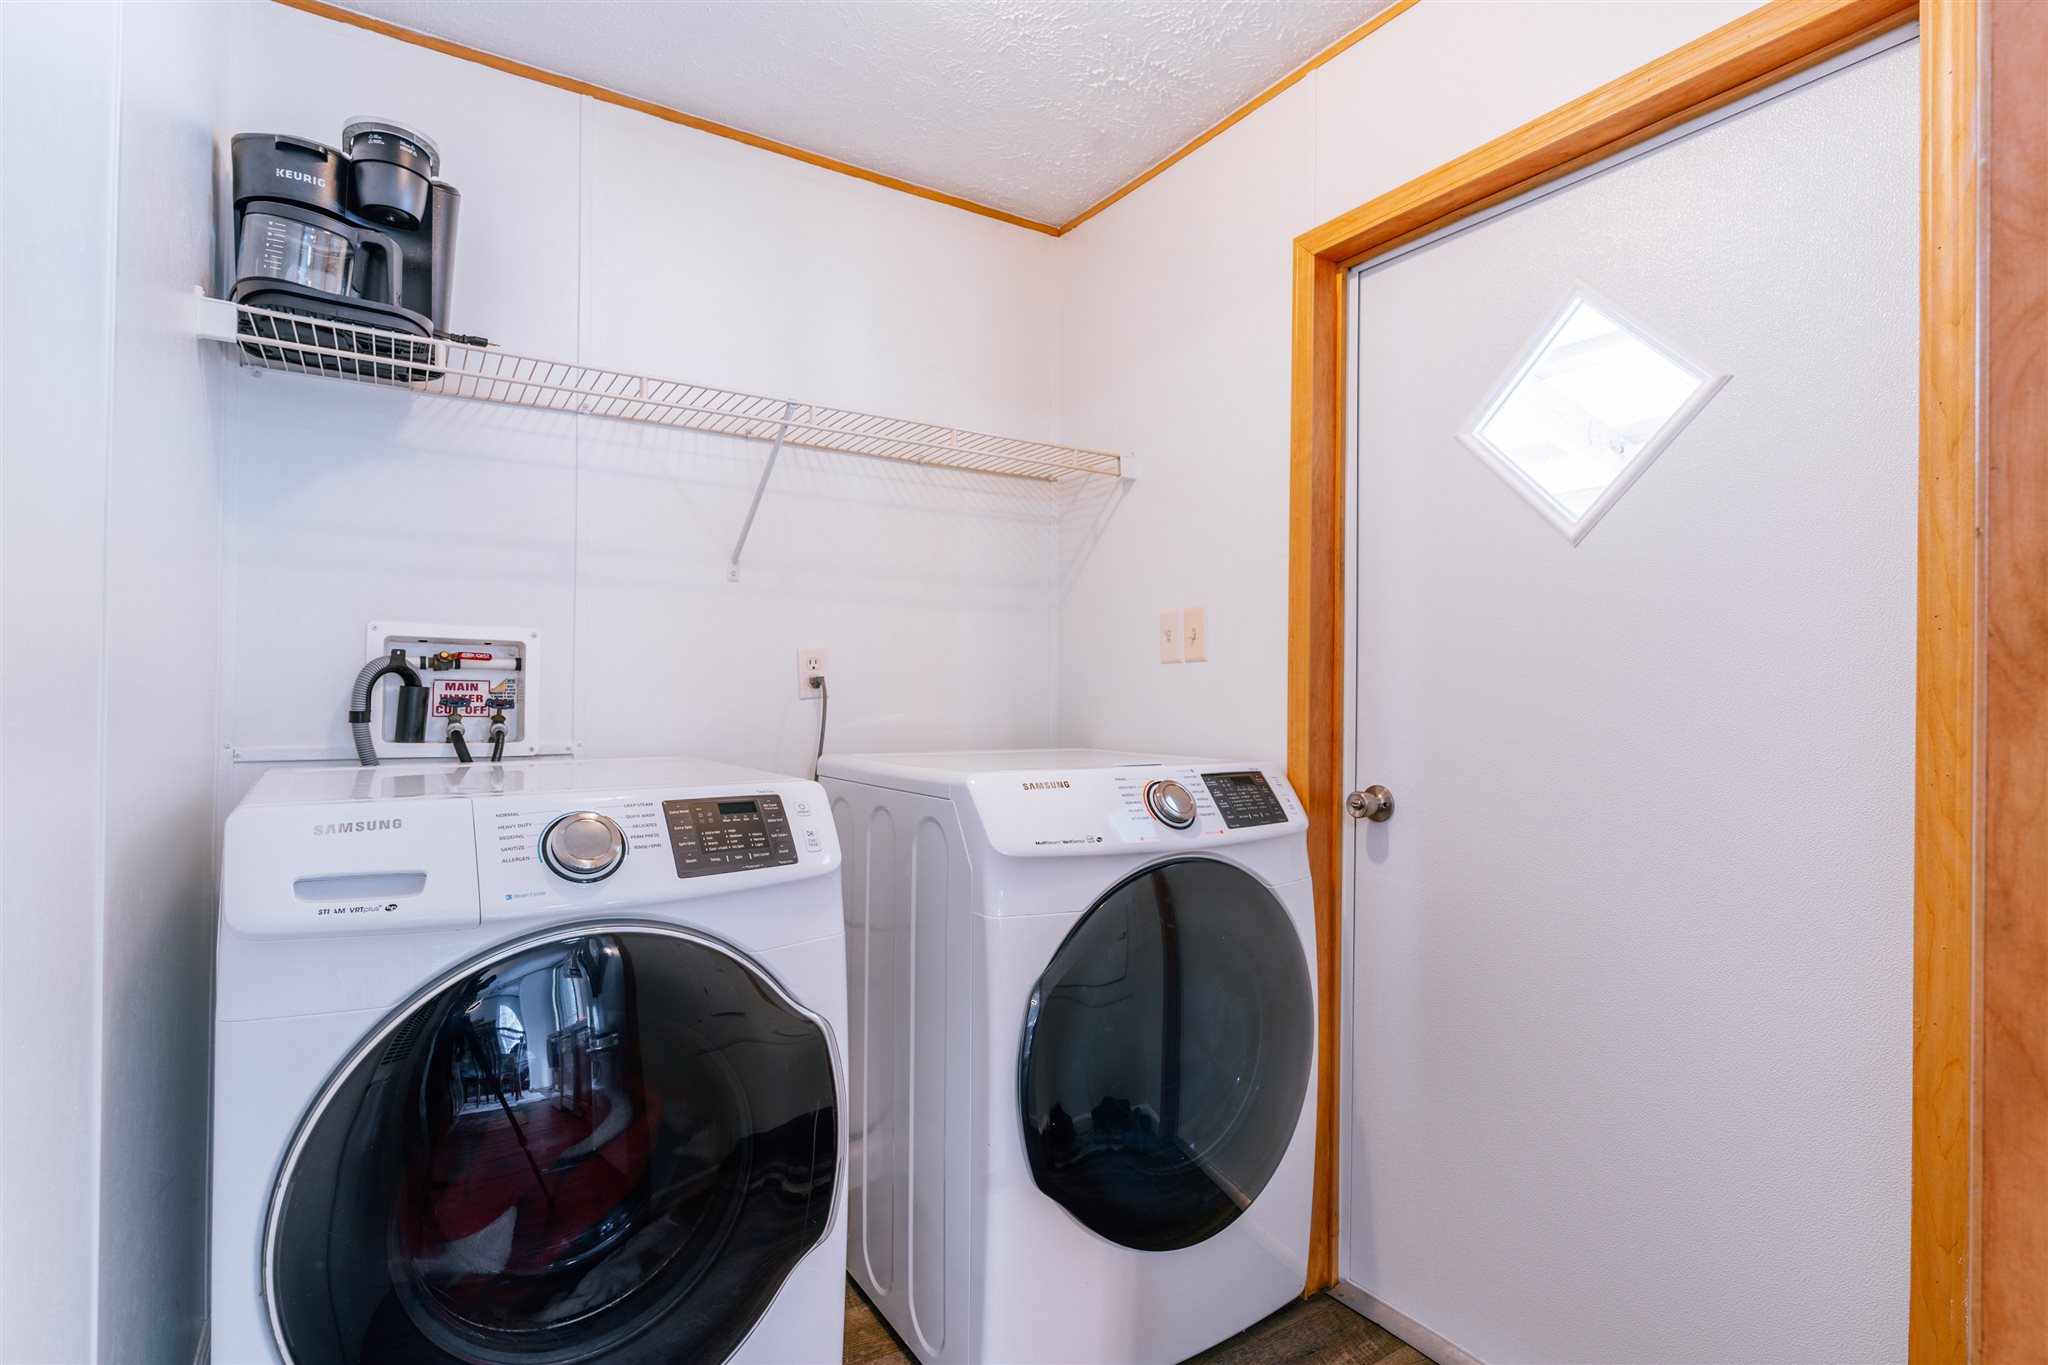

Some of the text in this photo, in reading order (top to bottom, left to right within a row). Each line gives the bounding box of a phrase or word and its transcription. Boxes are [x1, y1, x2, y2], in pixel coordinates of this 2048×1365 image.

[275, 167, 327, 188] KEURIG
[445, 682, 479, 692] MAIN
[435, 705, 487, 715] CU-OFF
[1022, 780, 1070, 791] SAMSUNG
[313, 819, 403, 836] SAMSUNG
[500, 845, 526, 853] SANITIZE
[501, 856, 531, 864] ALLERGEN
